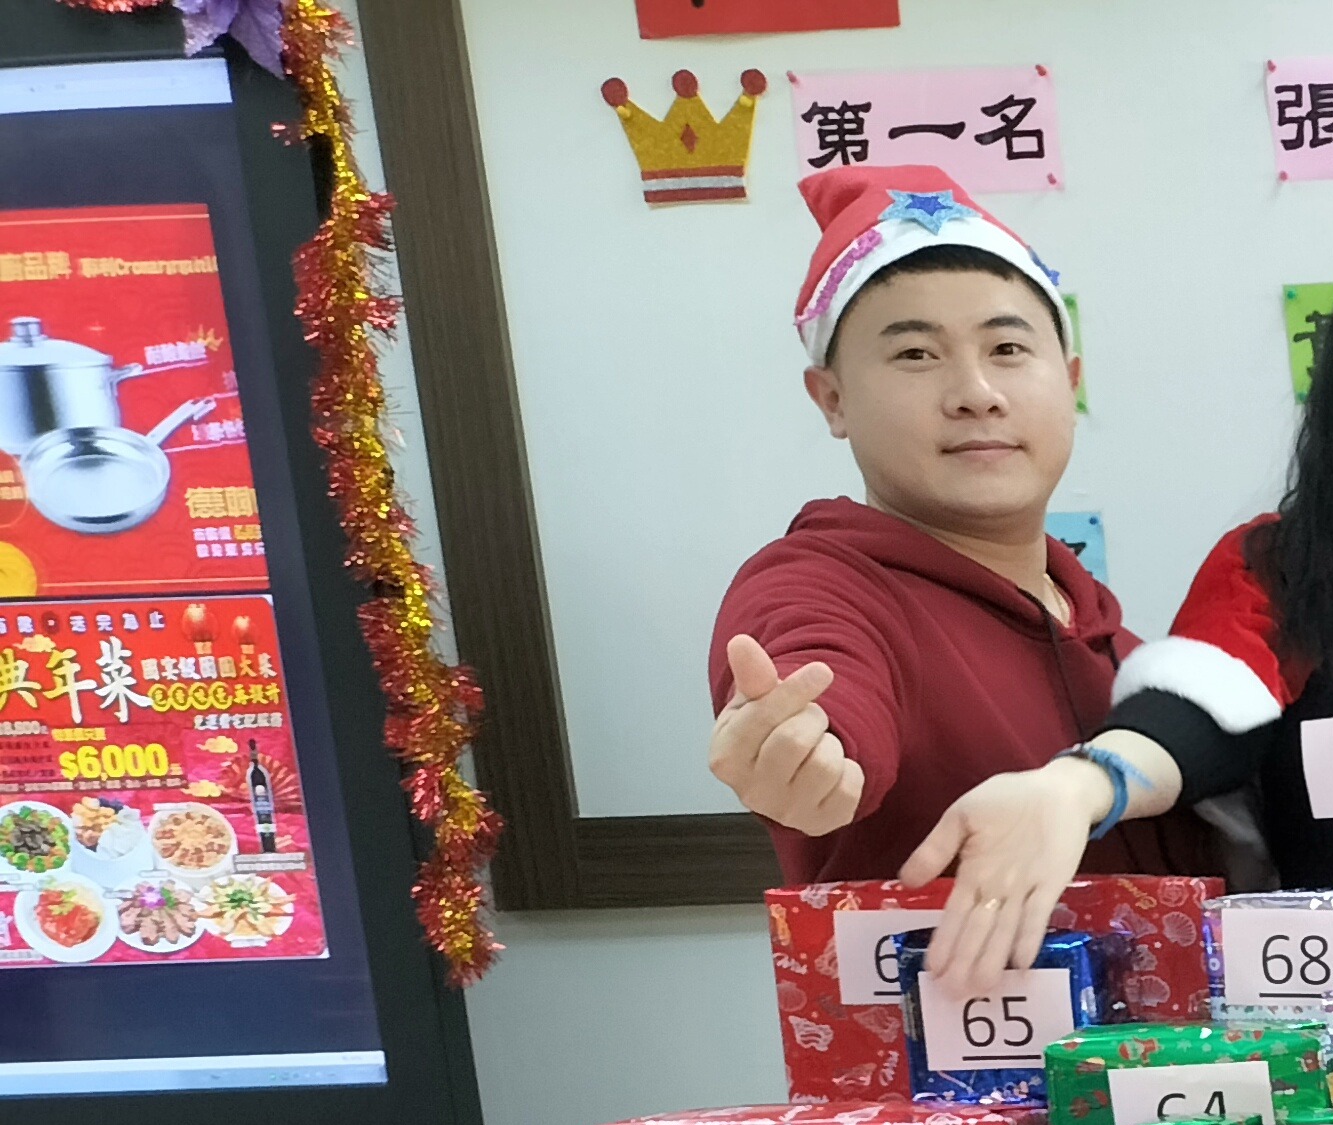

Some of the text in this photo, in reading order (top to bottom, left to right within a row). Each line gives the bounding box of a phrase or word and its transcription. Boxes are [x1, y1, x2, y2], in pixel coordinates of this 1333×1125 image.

[801, 94, 1045, 169] 第一名
[59, 743, 170, 781] $6,000
[1260, 934, 1332, 986] 68
[962, 996, 1034, 1048] 65
